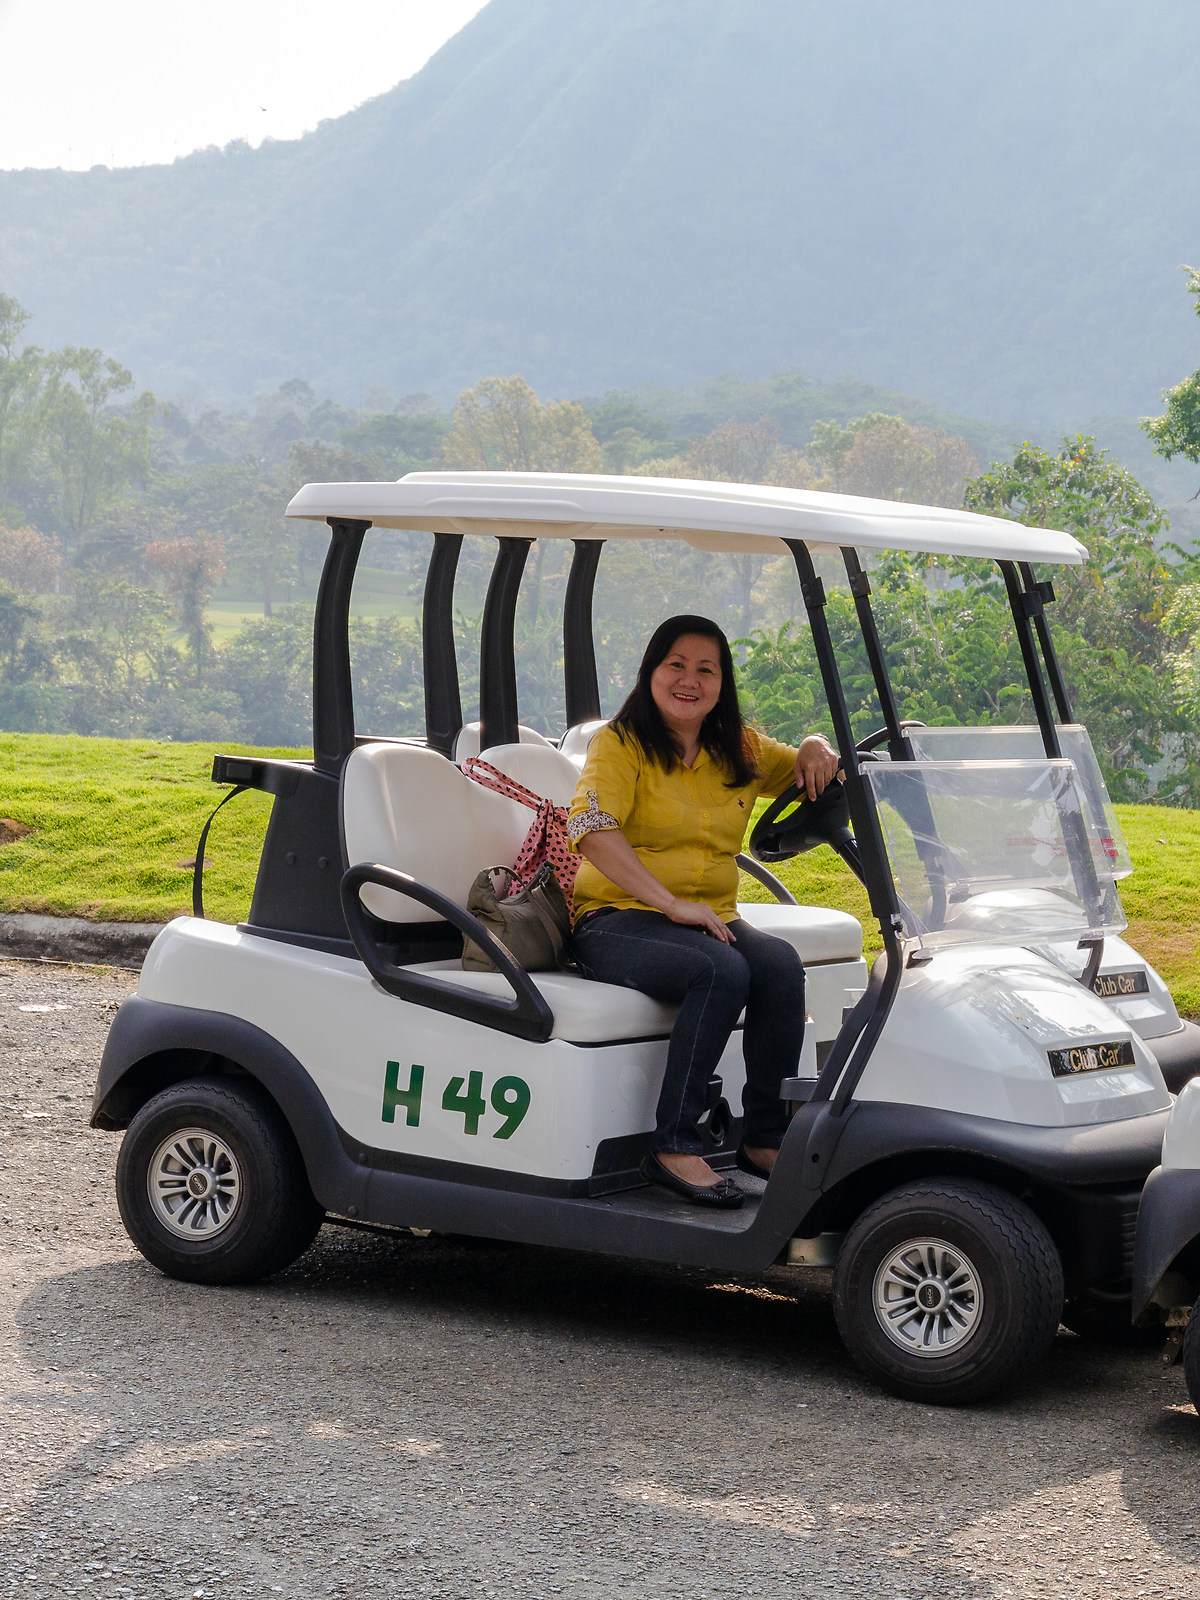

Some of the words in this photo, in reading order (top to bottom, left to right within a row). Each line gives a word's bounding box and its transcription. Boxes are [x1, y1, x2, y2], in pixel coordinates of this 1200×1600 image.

[1093, 976, 1117, 996] Club
[1118, 974, 1136, 994] Car
[1069, 1048, 1098, 1071] Club
[1099, 1045, 1120, 1067] Car
